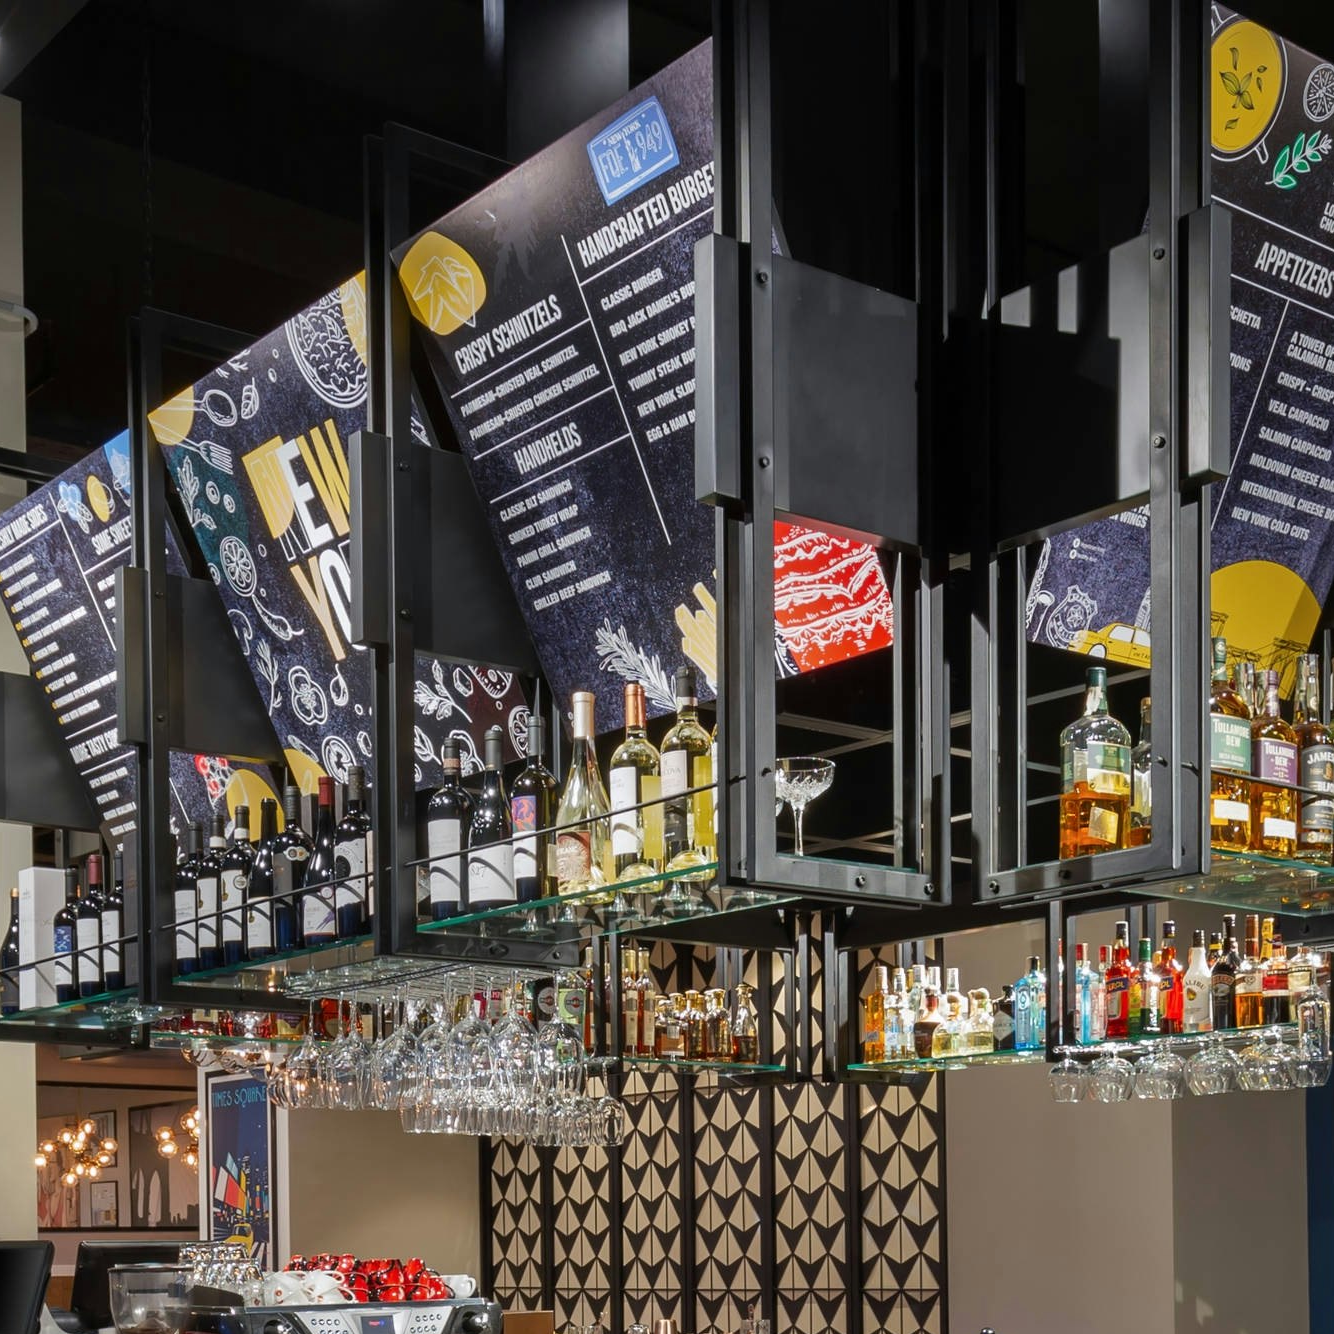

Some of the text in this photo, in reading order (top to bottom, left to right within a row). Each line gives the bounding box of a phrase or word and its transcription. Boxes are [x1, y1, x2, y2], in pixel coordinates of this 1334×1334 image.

[577, 160, 714, 268] HANDCRAFTED BURGE
[600, 267, 664, 311] CLASSIC BURGER
[609, 319, 628, 338] BBQ
[627, 308, 648, 329] JACK
[645, 290, 681, 318] DANIEL'S
[454, 294, 562, 375] CRISPY SCHNITZELS
[619, 345, 638, 366] NEW
[636, 336, 659, 357] YORK
[657, 321, 690, 346] SMOKEY
[1290, 331, 1299, 344] A
[1298, 334, 1325, 354] TOWER
[627, 367, 657, 392] YUMMY
[656, 356, 683, 378] STEAK
[1287, 344, 1326, 369] CALAMARI
[460, 344, 579, 418] PARMESAN-CRUSTED VEAL SCHNITZEL
[1277, 371, 1307, 393] CRISPY
[469, 363, 600, 441] PARMESAN-CRUSTED CHICKEN SCHNITZEL
[637, 399, 656, 418] NEW
[655, 388, 677, 408] YORK
[1267, 398, 1330, 432] VEAL CARPACCIO
[646, 413, 689, 443] EGG & HAM
[1258, 426, 1332, 462] SALMON CARPACCIO
[513, 422, 582, 475] HANDHELDS
[1249, 452, 1292, 477] MOLDOVAN
[1290, 467, 1320, 487] CHEESE
[499, 503, 527, 522] CLASSIC
[537, 479, 573, 505] SANDWICH
[1240, 480, 1298, 510] INTERNATIONAL
[1296, 498, 1325, 519] CHEESE
[556, 526, 592, 550] SANDWICH
[1231, 506, 1311, 541] NEW YORK COLD CUTS
[542, 560, 577, 583] SANDWICH
[575, 570, 612, 594] SANDWICH
